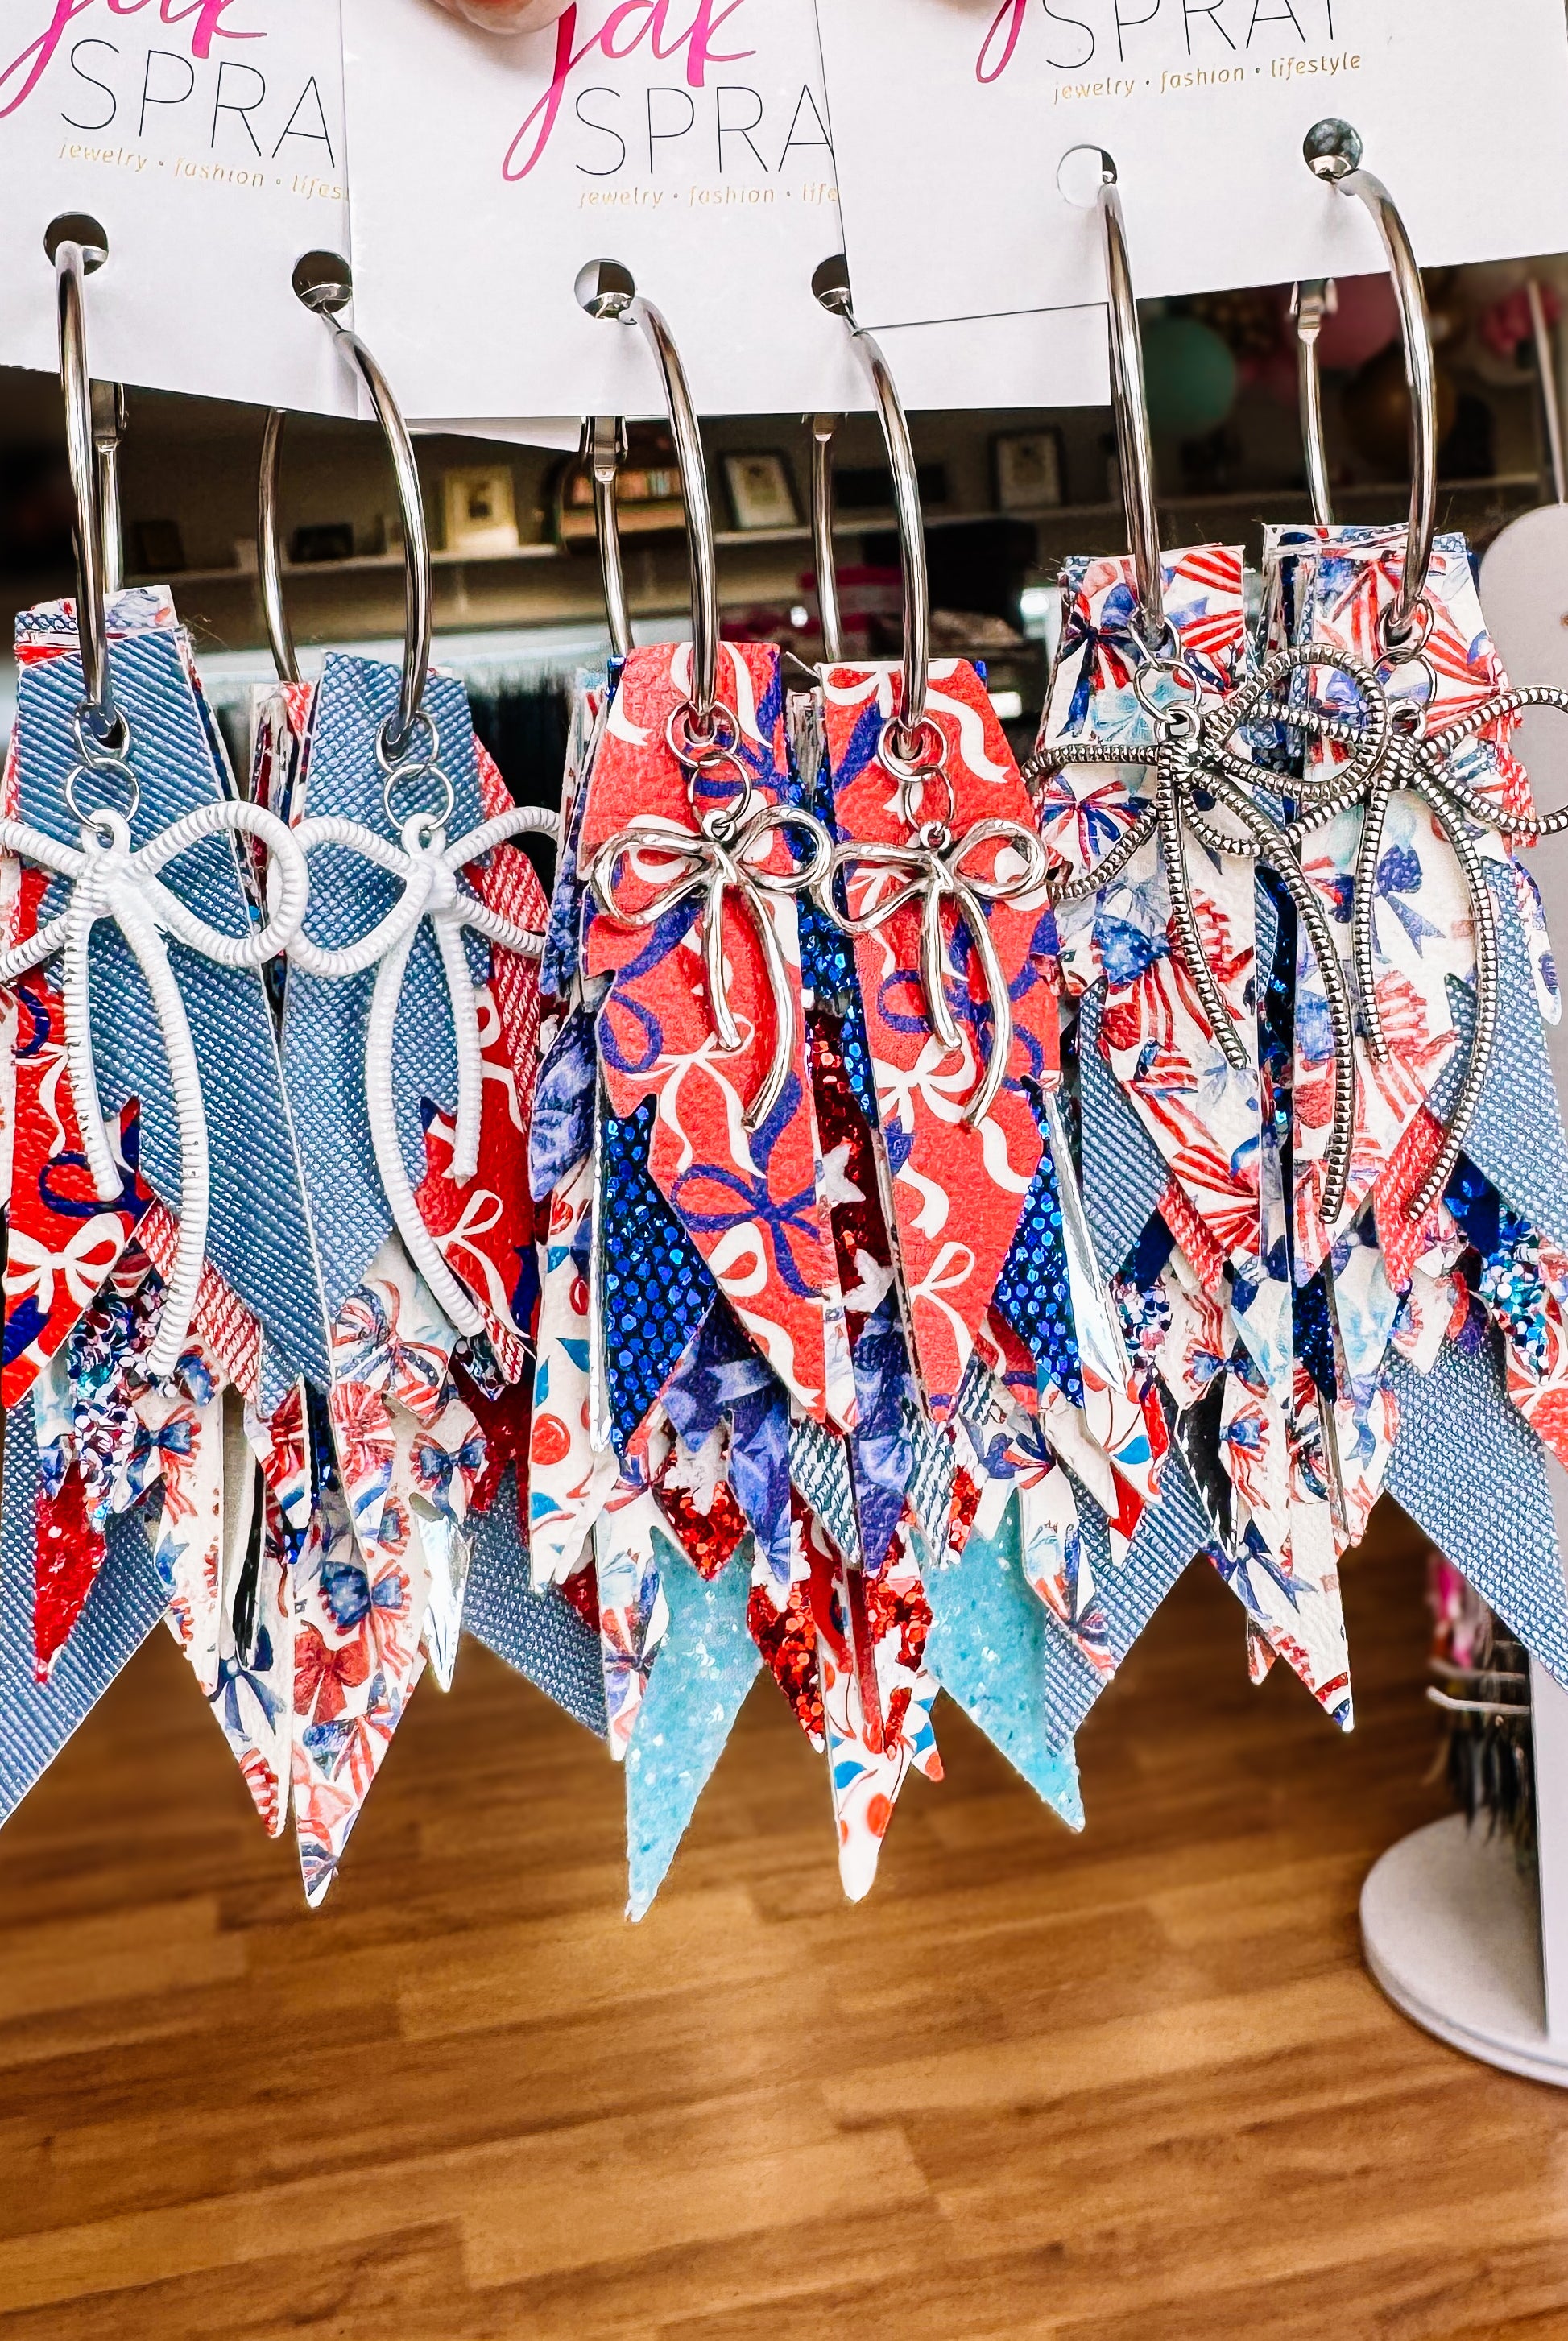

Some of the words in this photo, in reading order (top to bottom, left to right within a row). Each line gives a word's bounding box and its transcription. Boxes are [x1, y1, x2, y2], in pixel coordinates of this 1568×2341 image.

[1053, 75, 1135, 105] jewelry
[1160, 67, 1245, 94] fashion
[1271, 52, 1362, 81] lifestyle
[58, 139, 148, 173] jewelry
[173, 156, 264, 188] fashion
[579, 185, 664, 210] jewelry
[689, 184, 775, 207] fashion
